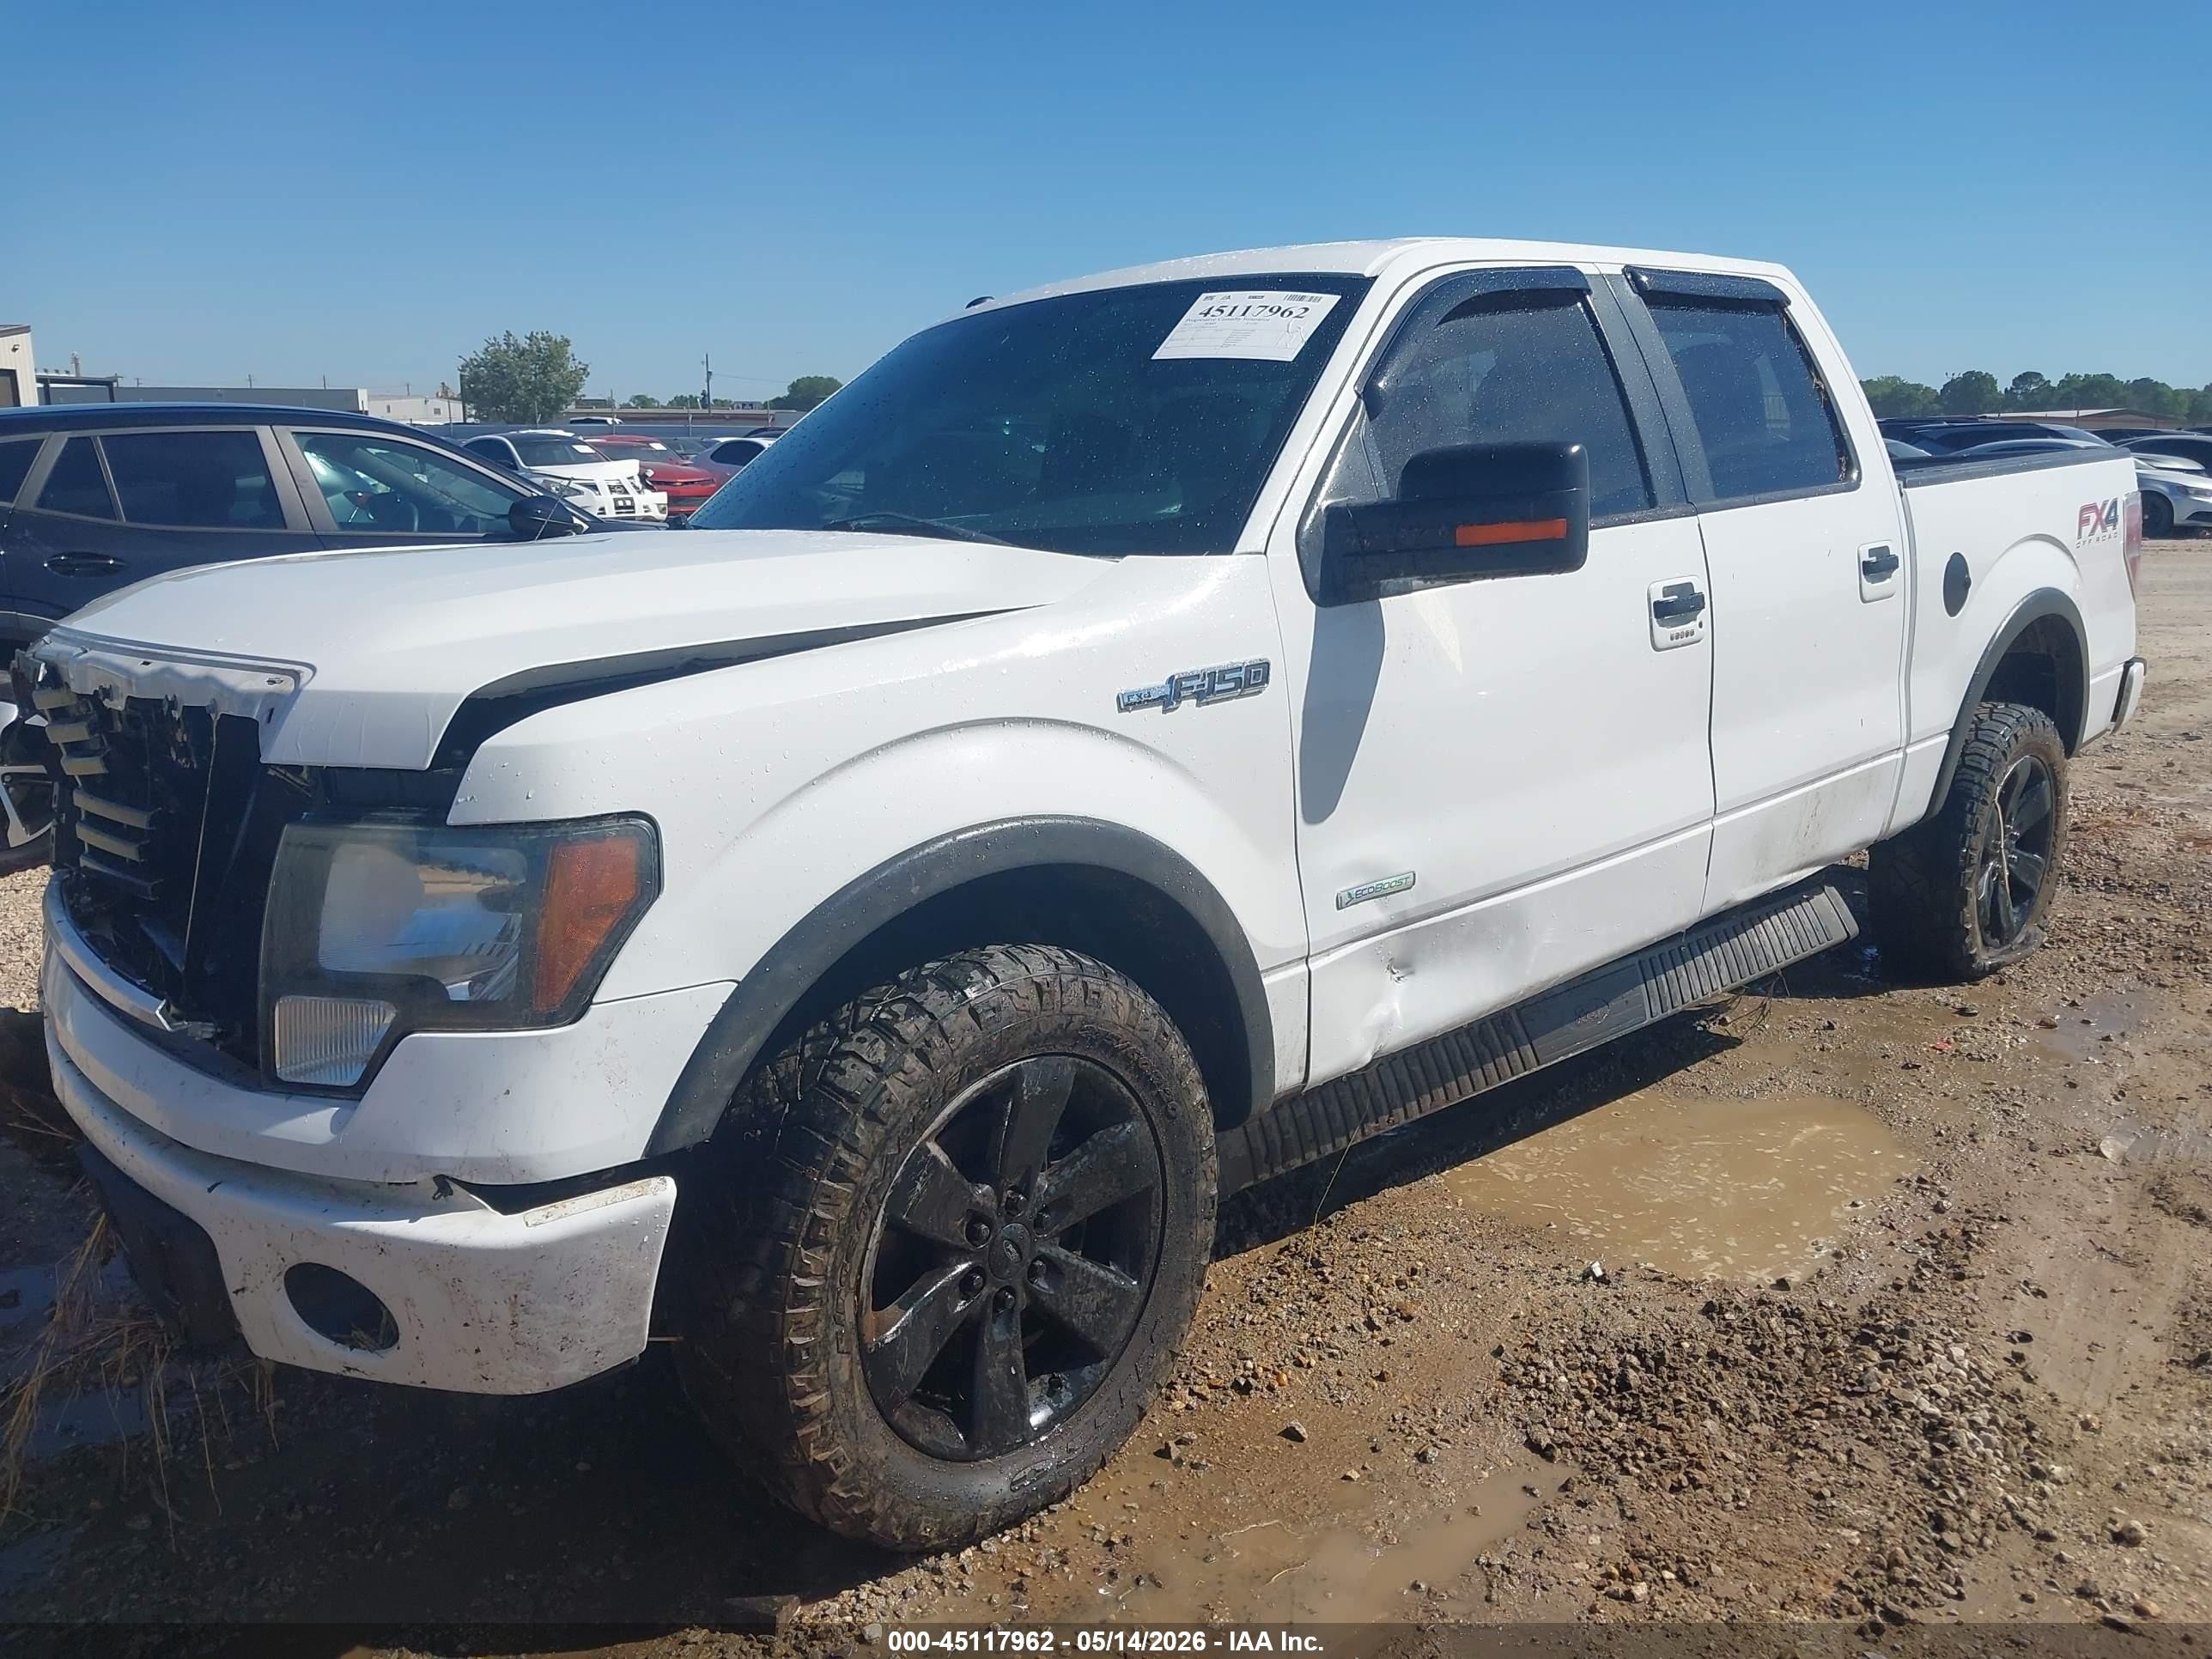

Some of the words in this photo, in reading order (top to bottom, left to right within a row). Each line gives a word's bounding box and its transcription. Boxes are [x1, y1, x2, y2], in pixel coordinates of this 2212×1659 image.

[1199, 305, 1310, 319] 45117962
[2076, 497, 2119, 539] FX4
[1163, 659, 1271, 713] F-150
